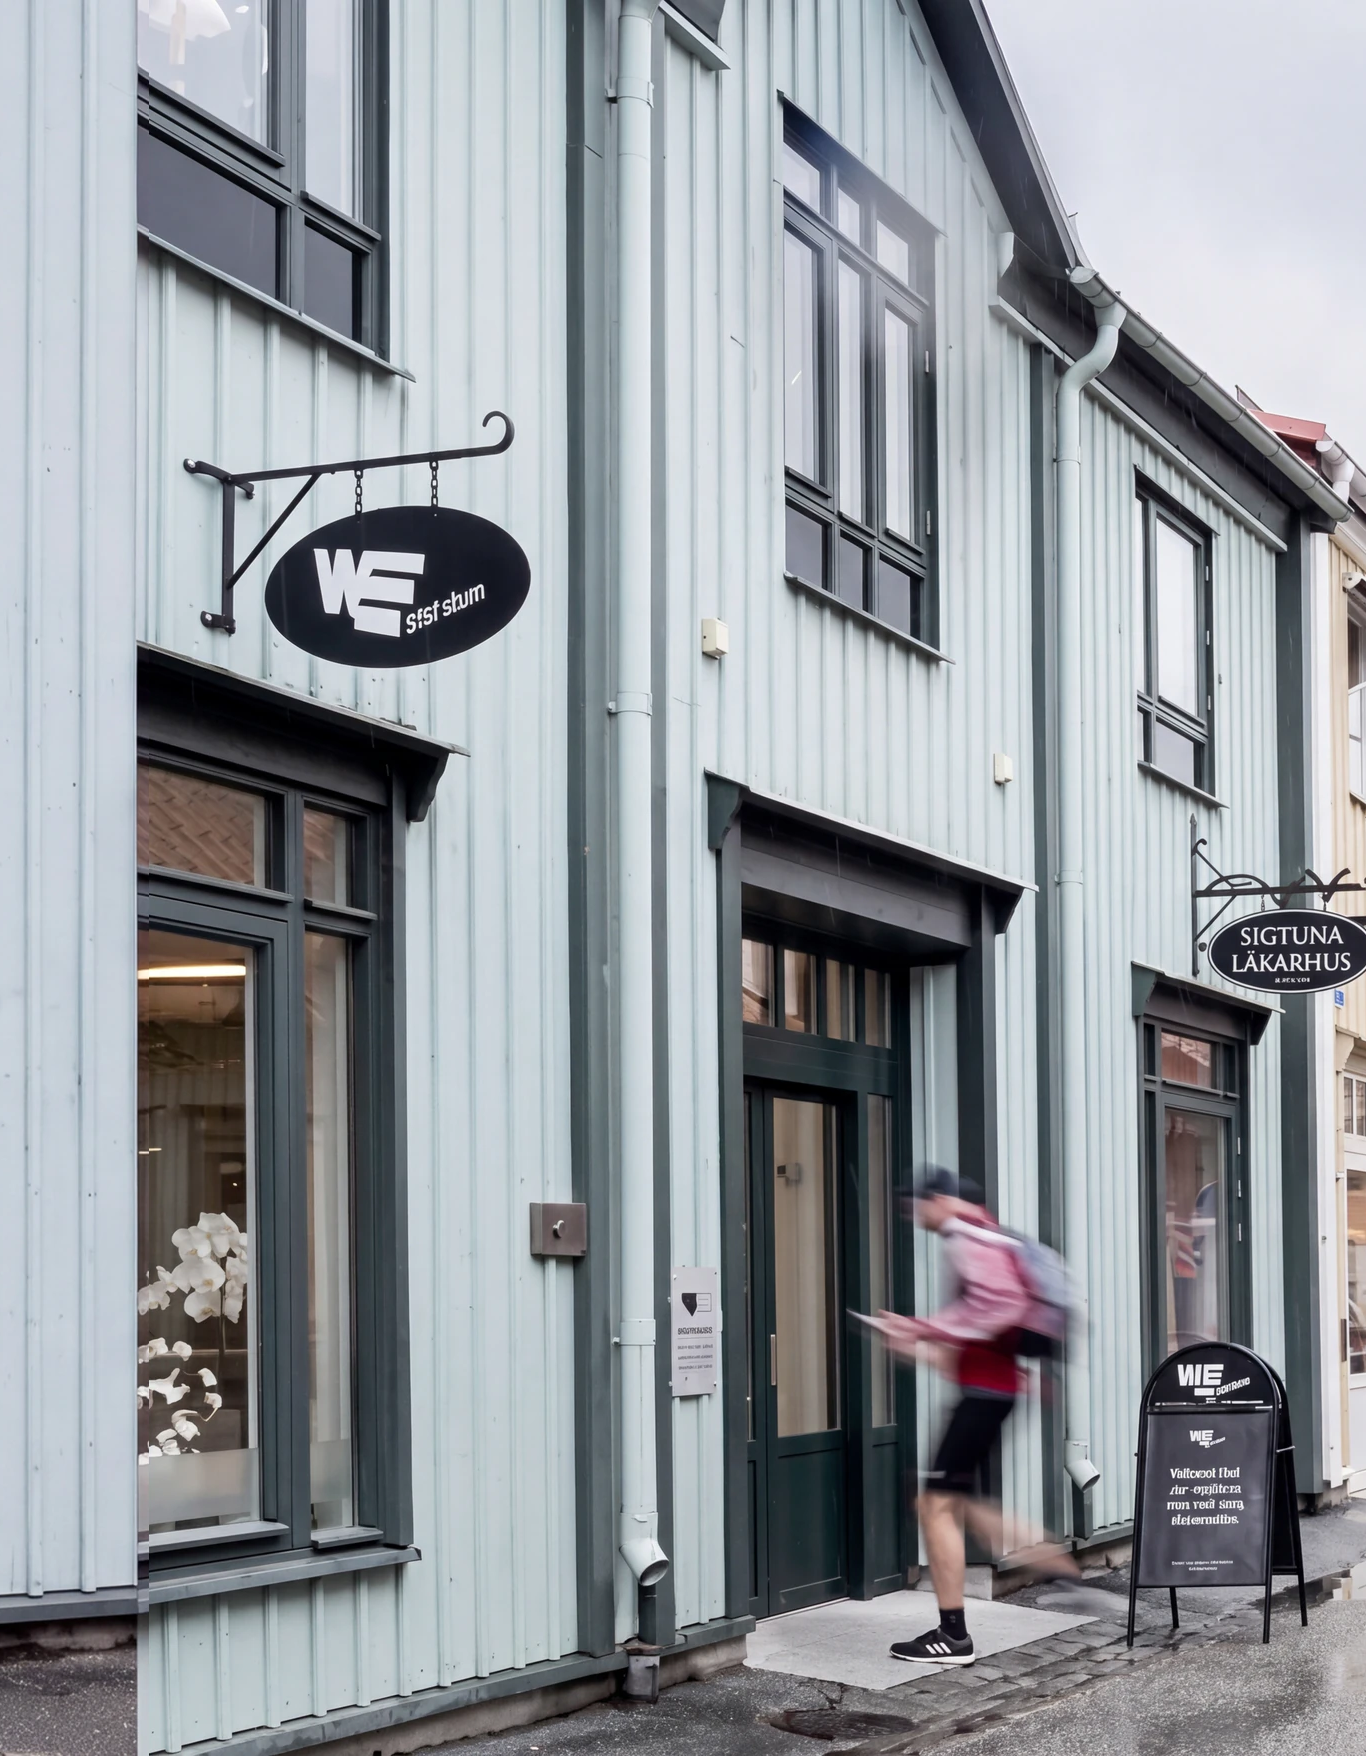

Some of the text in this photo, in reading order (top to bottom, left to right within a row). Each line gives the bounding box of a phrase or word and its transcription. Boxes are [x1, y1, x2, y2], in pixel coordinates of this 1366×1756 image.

[313, 548, 425, 637] WE
[1240, 925, 1344, 946] SIGTUNA
[1232, 950, 1351, 972] LÄKARHUS
